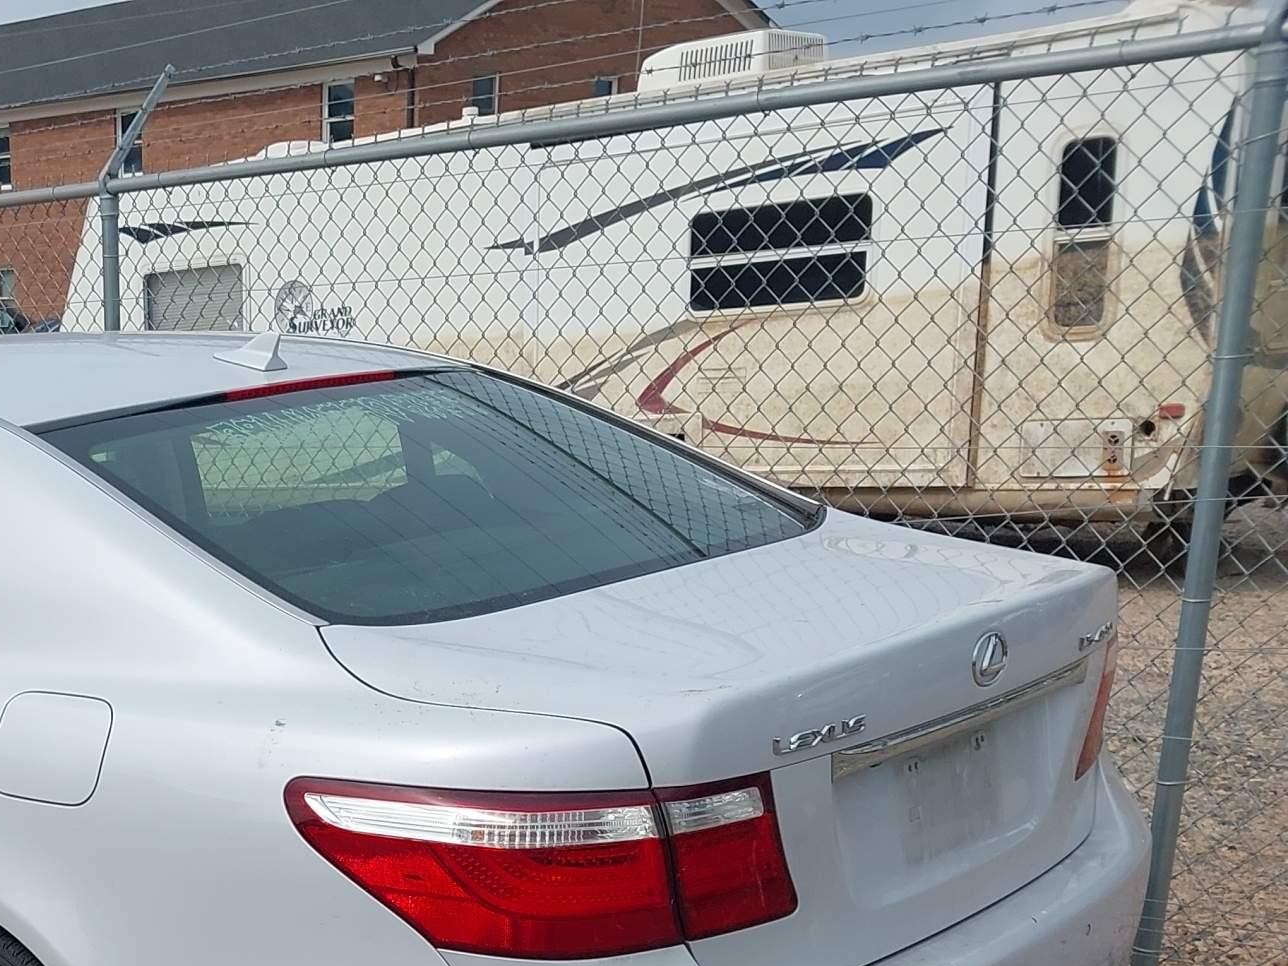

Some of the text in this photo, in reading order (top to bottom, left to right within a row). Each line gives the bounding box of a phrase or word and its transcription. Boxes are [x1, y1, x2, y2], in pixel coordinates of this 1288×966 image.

[313, 306, 352, 320] GRAND
[287, 317, 353, 334] SURVEYOR
[772, 713, 866, 756] LEXUS
